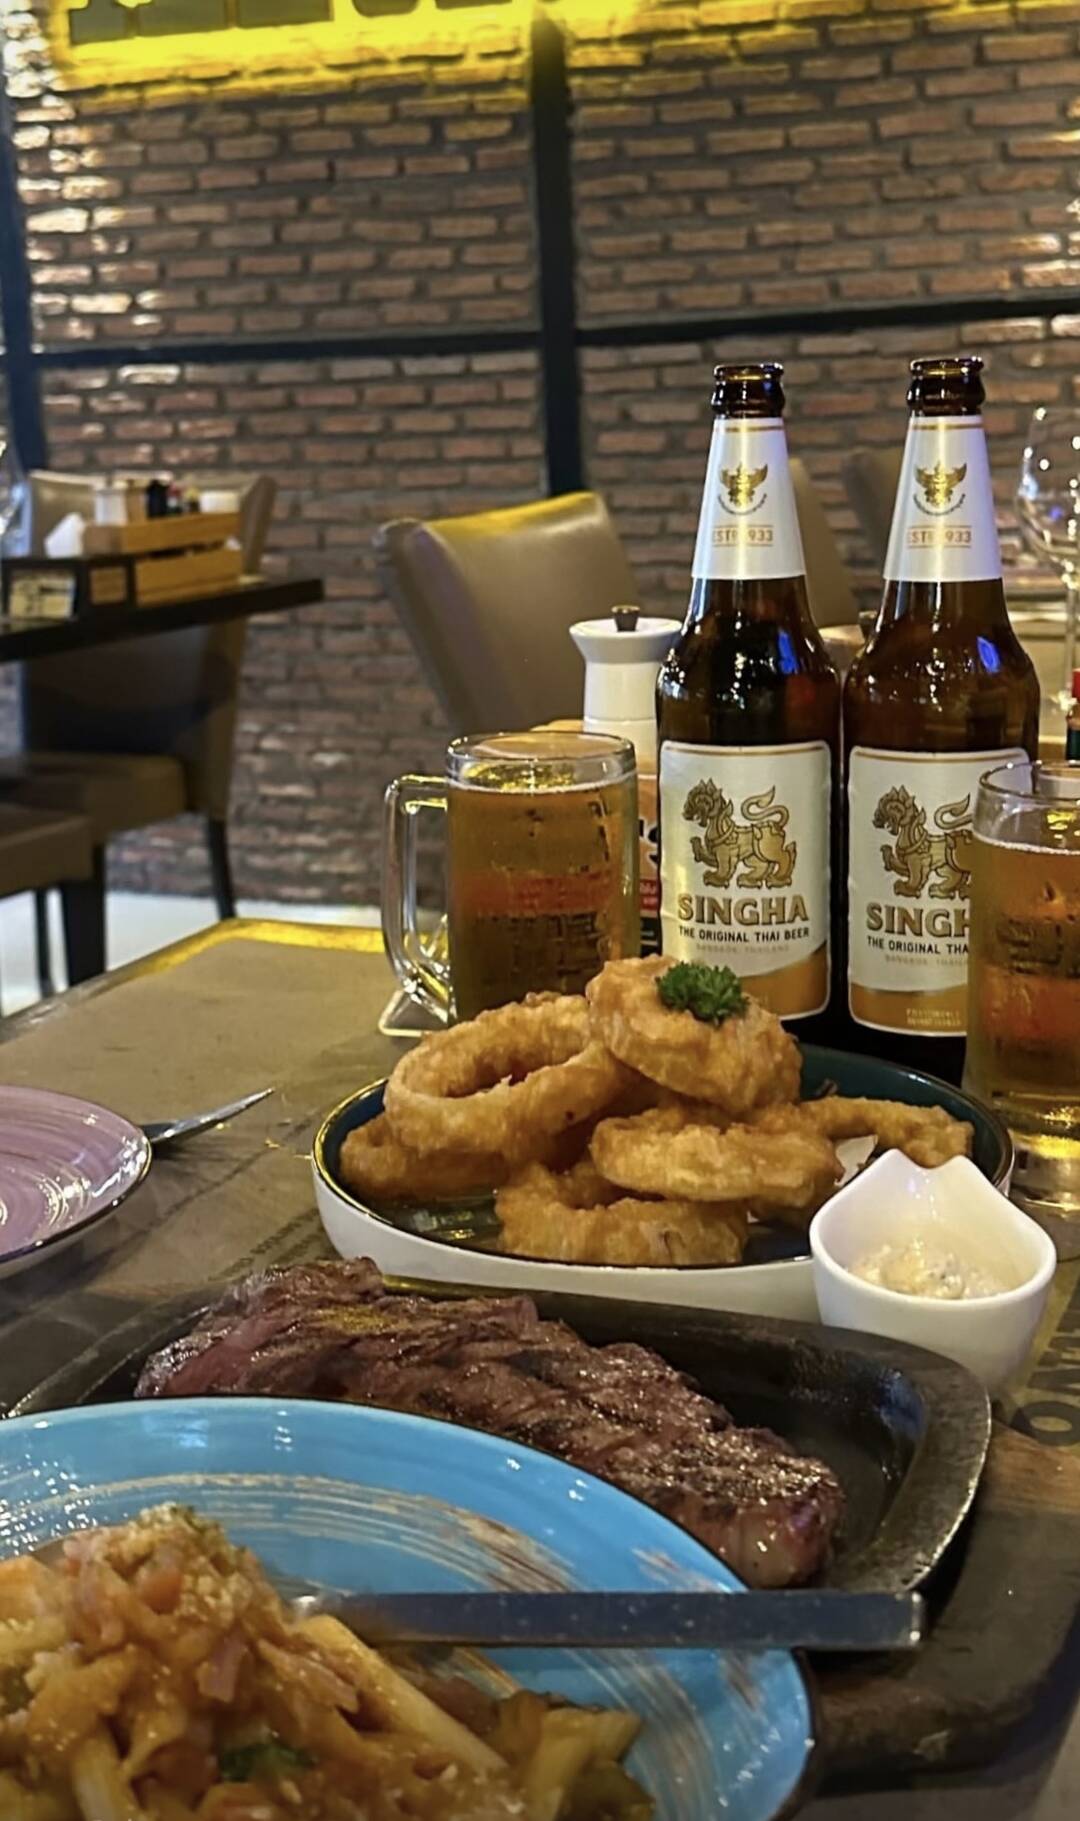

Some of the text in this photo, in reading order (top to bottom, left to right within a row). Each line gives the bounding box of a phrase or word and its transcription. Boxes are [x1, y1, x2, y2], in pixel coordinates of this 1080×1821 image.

[745, 529, 774, 542] 933
[944, 530, 972, 543] 933
[677, 892, 809, 927] SINGHA
[866, 902, 970, 938] SINGH
[679, 925, 809, 943] THE ORIGINAL THAI BEER
[867, 936, 969, 955] THE ORIGINAL THA
